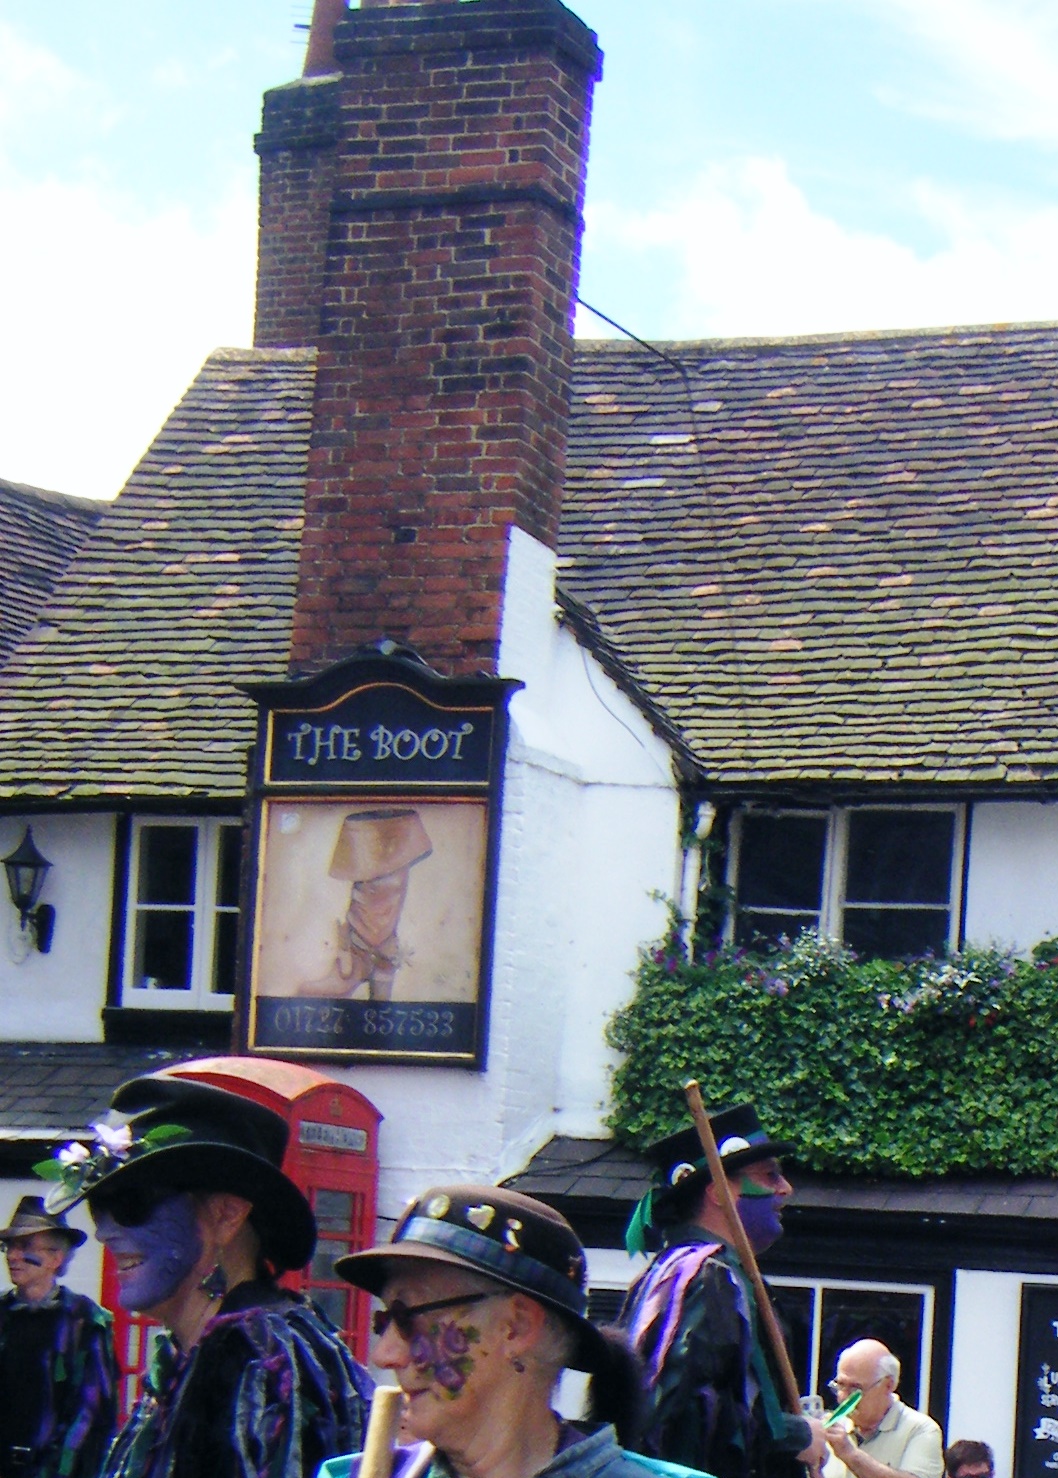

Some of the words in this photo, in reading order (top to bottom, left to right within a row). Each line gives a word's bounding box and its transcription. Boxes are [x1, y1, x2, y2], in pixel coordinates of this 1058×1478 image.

[288, 722, 362, 765] THE
[370, 722, 473, 761] BOOT
[275, 1005, 344, 1034] 01727
[363, 1008, 454, 1037] 857533
